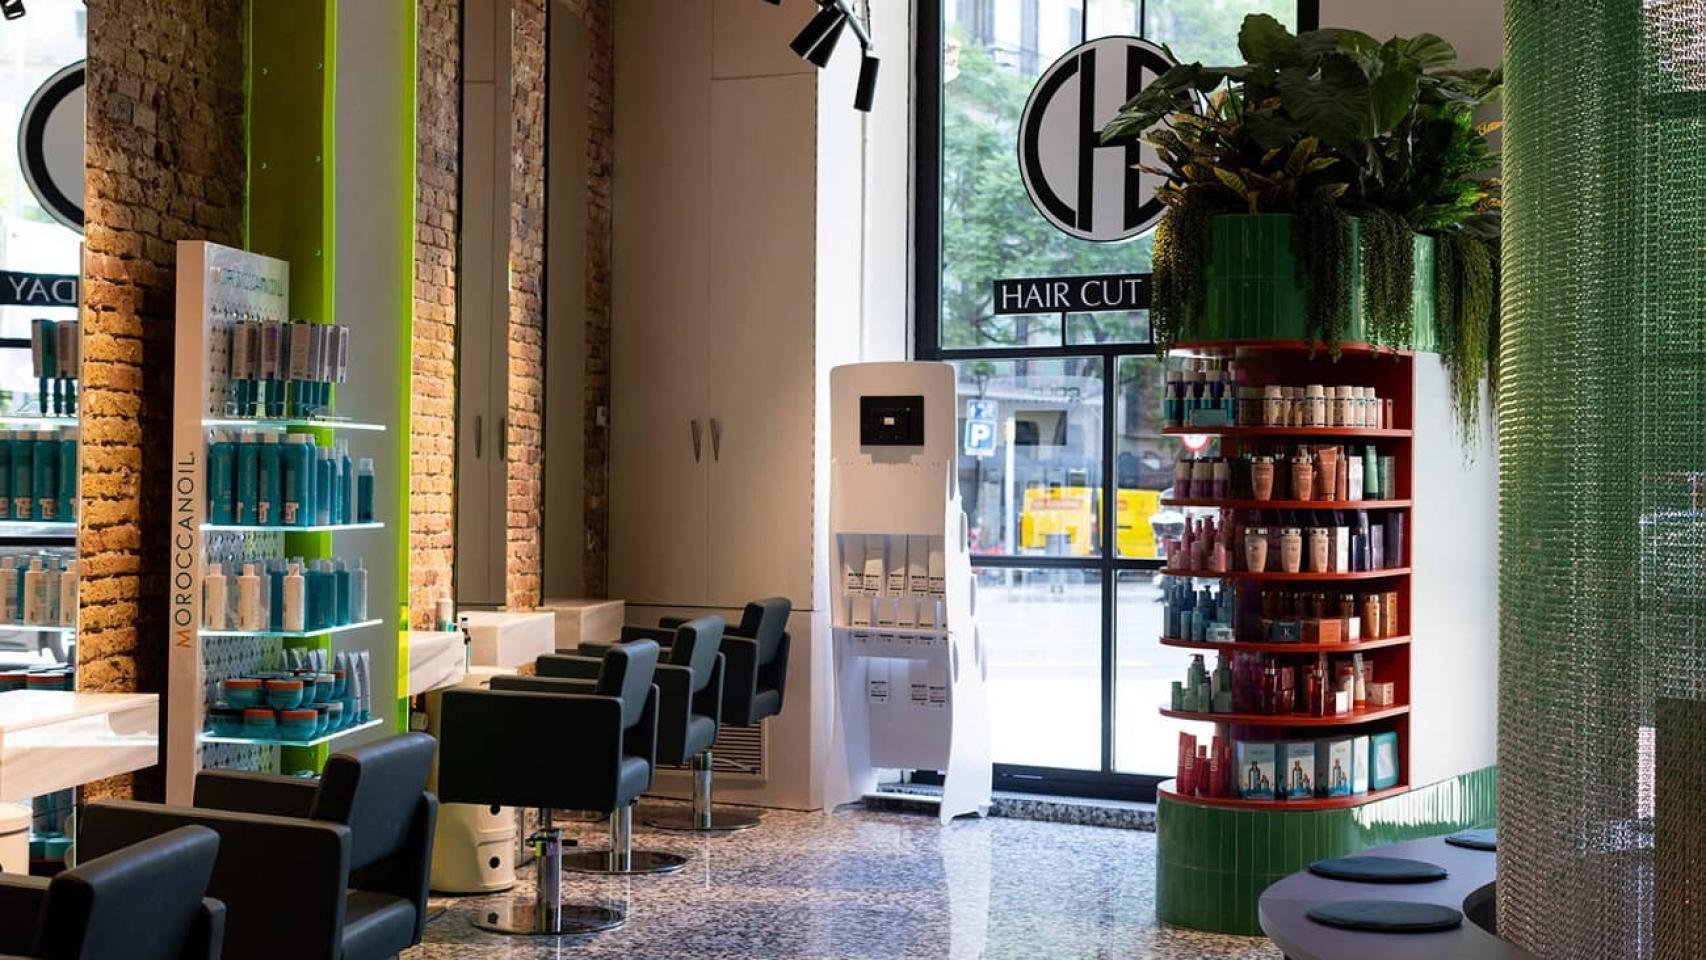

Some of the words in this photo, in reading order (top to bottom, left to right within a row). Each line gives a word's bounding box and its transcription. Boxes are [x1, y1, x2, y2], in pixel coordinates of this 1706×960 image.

[1002, 281, 1071, 310] HAIR
[1080, 279, 1143, 307] CUT
[971, 424, 990, 447] P
